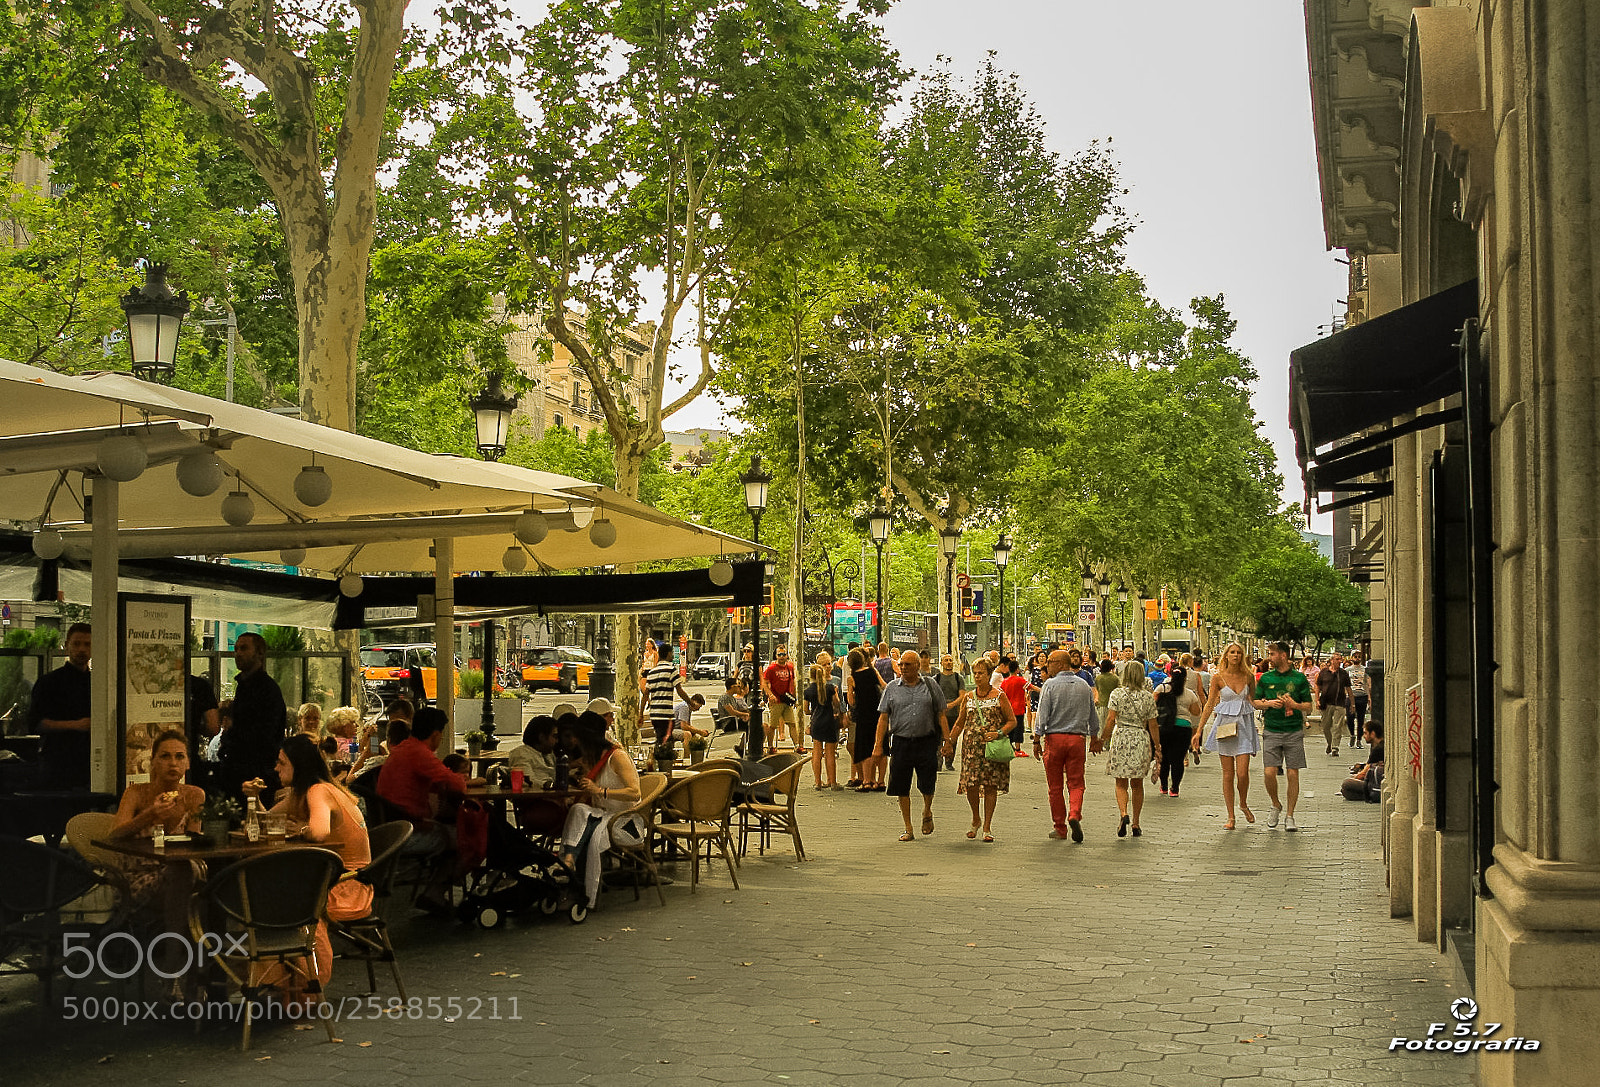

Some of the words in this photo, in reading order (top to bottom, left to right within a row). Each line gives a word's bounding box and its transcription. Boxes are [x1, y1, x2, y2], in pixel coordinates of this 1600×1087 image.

[128, 629, 149, 639] Pasta
[150, 630, 157, 639] &
[158, 629, 181, 640] Pizzas
